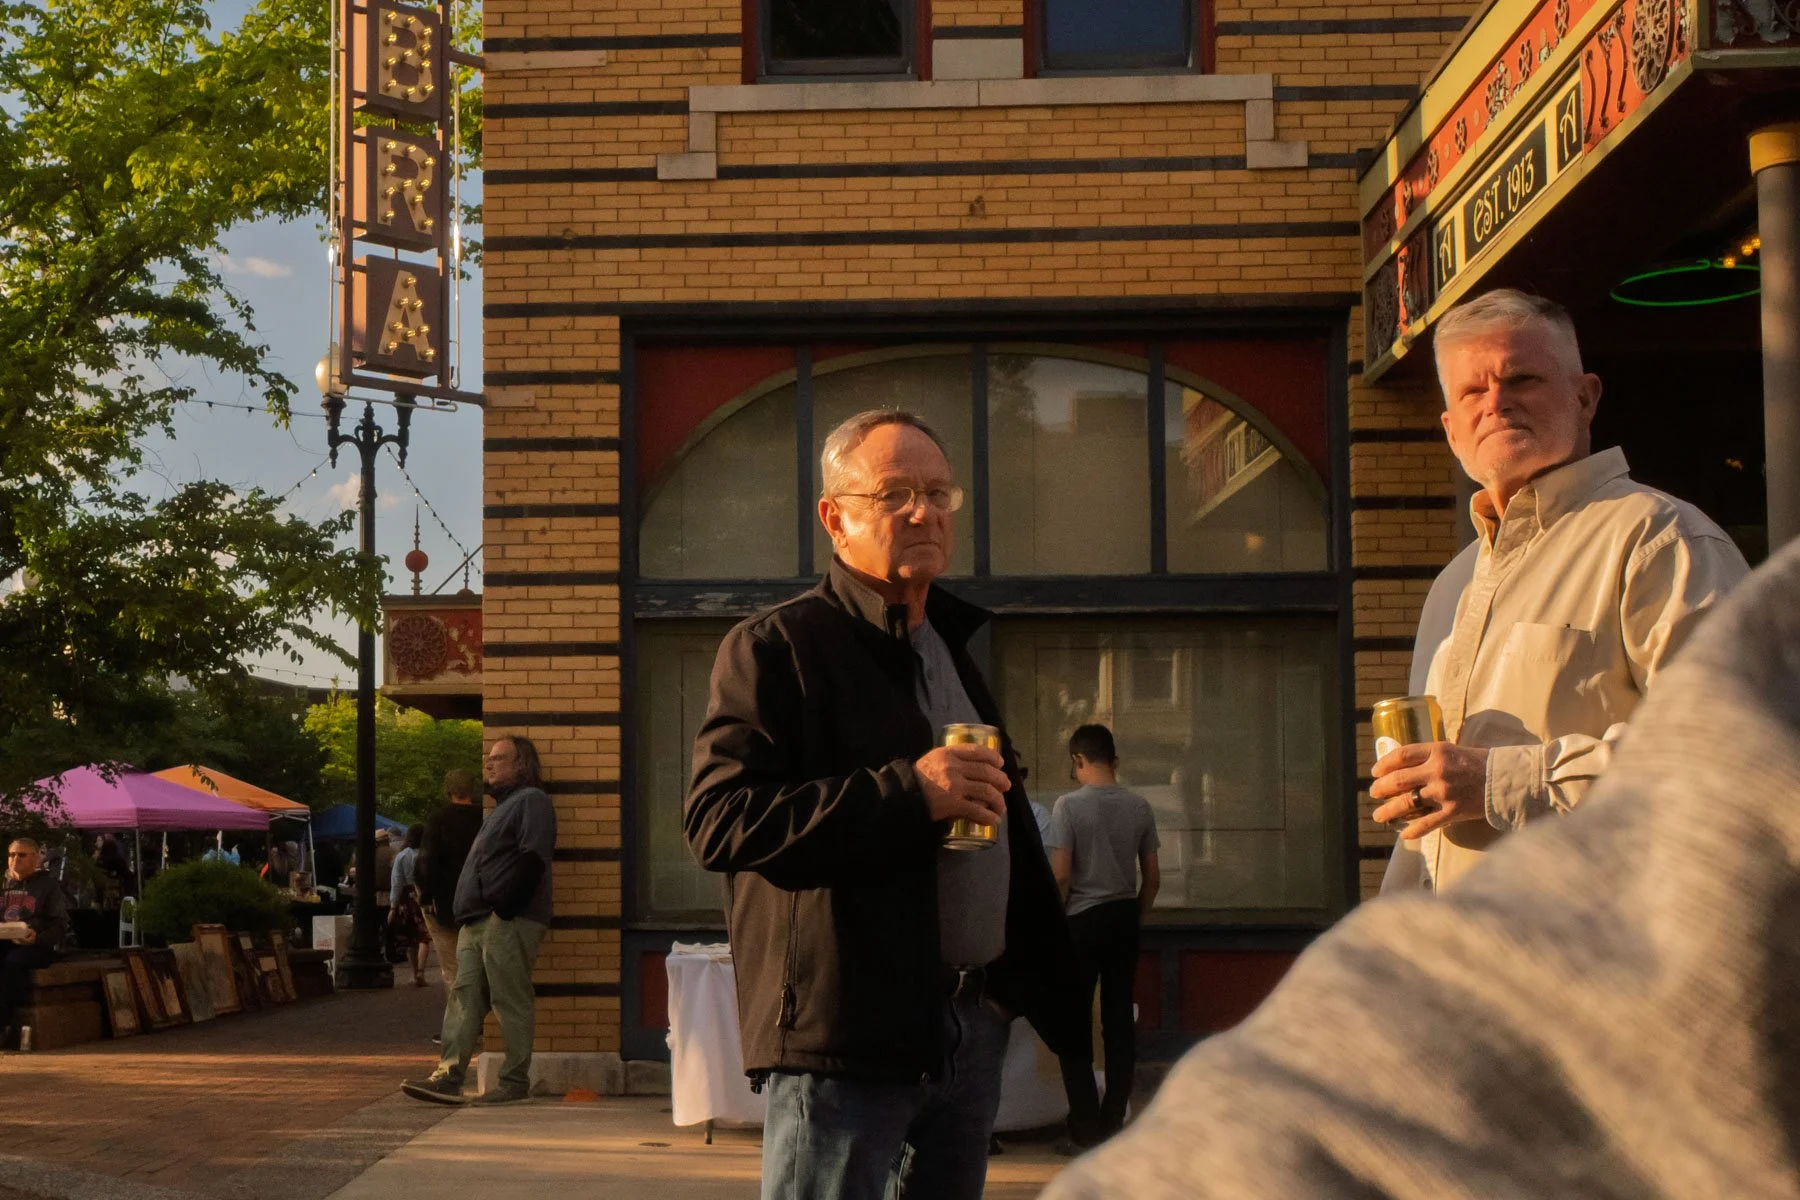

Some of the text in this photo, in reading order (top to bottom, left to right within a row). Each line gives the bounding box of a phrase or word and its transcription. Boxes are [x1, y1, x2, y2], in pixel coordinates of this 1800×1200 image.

[1558, 89, 1577, 161] A
[1507, 148, 1534, 212] 1913
[1439, 224, 1451, 282] A
